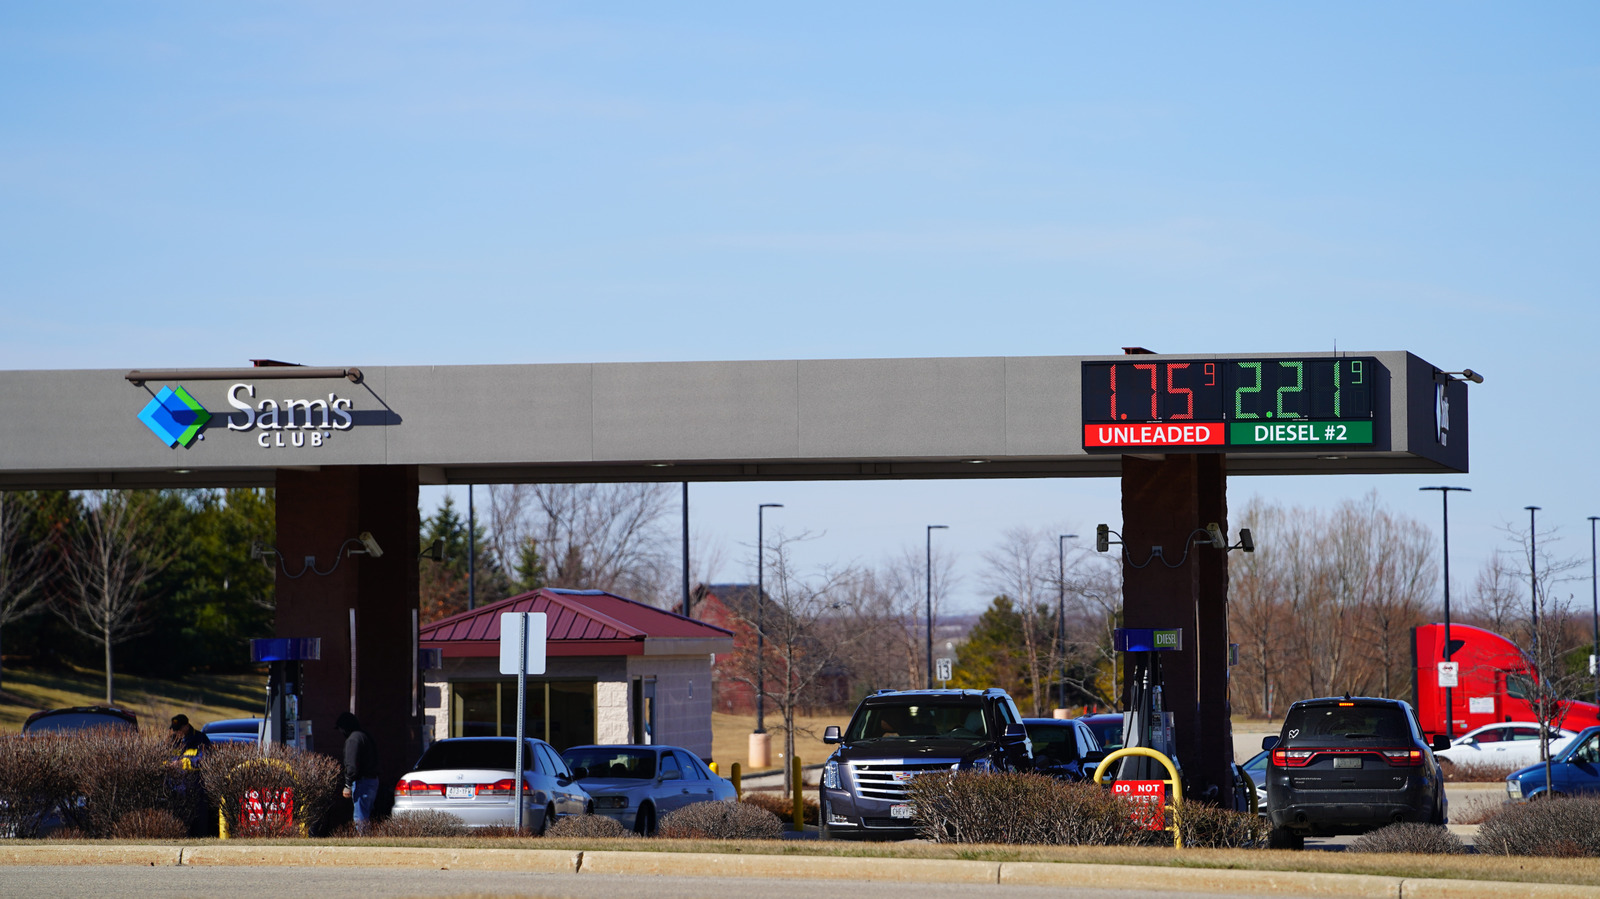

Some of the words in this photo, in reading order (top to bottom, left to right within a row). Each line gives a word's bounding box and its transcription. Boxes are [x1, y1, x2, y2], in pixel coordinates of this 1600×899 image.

[1110, 363, 1193, 420] 1.75
[1204, 363, 1215, 386] 9
[1235, 360, 1340, 419] 2.21
[1351, 361, 1362, 384] 9
[227, 383, 353, 431] Sam's
[258, 431, 323, 448] CLUB
[1099, 426, 1210, 444] UNLEADED
[1254, 424, 1320, 442] DIESEL
[1324, 424, 1347, 441] #2
[1156, 633, 1177, 645] DIESEL
[938, 664, 950, 680] 13
[1115, 784, 1131, 793] DO
[1137, 784, 1160, 793] NOT
